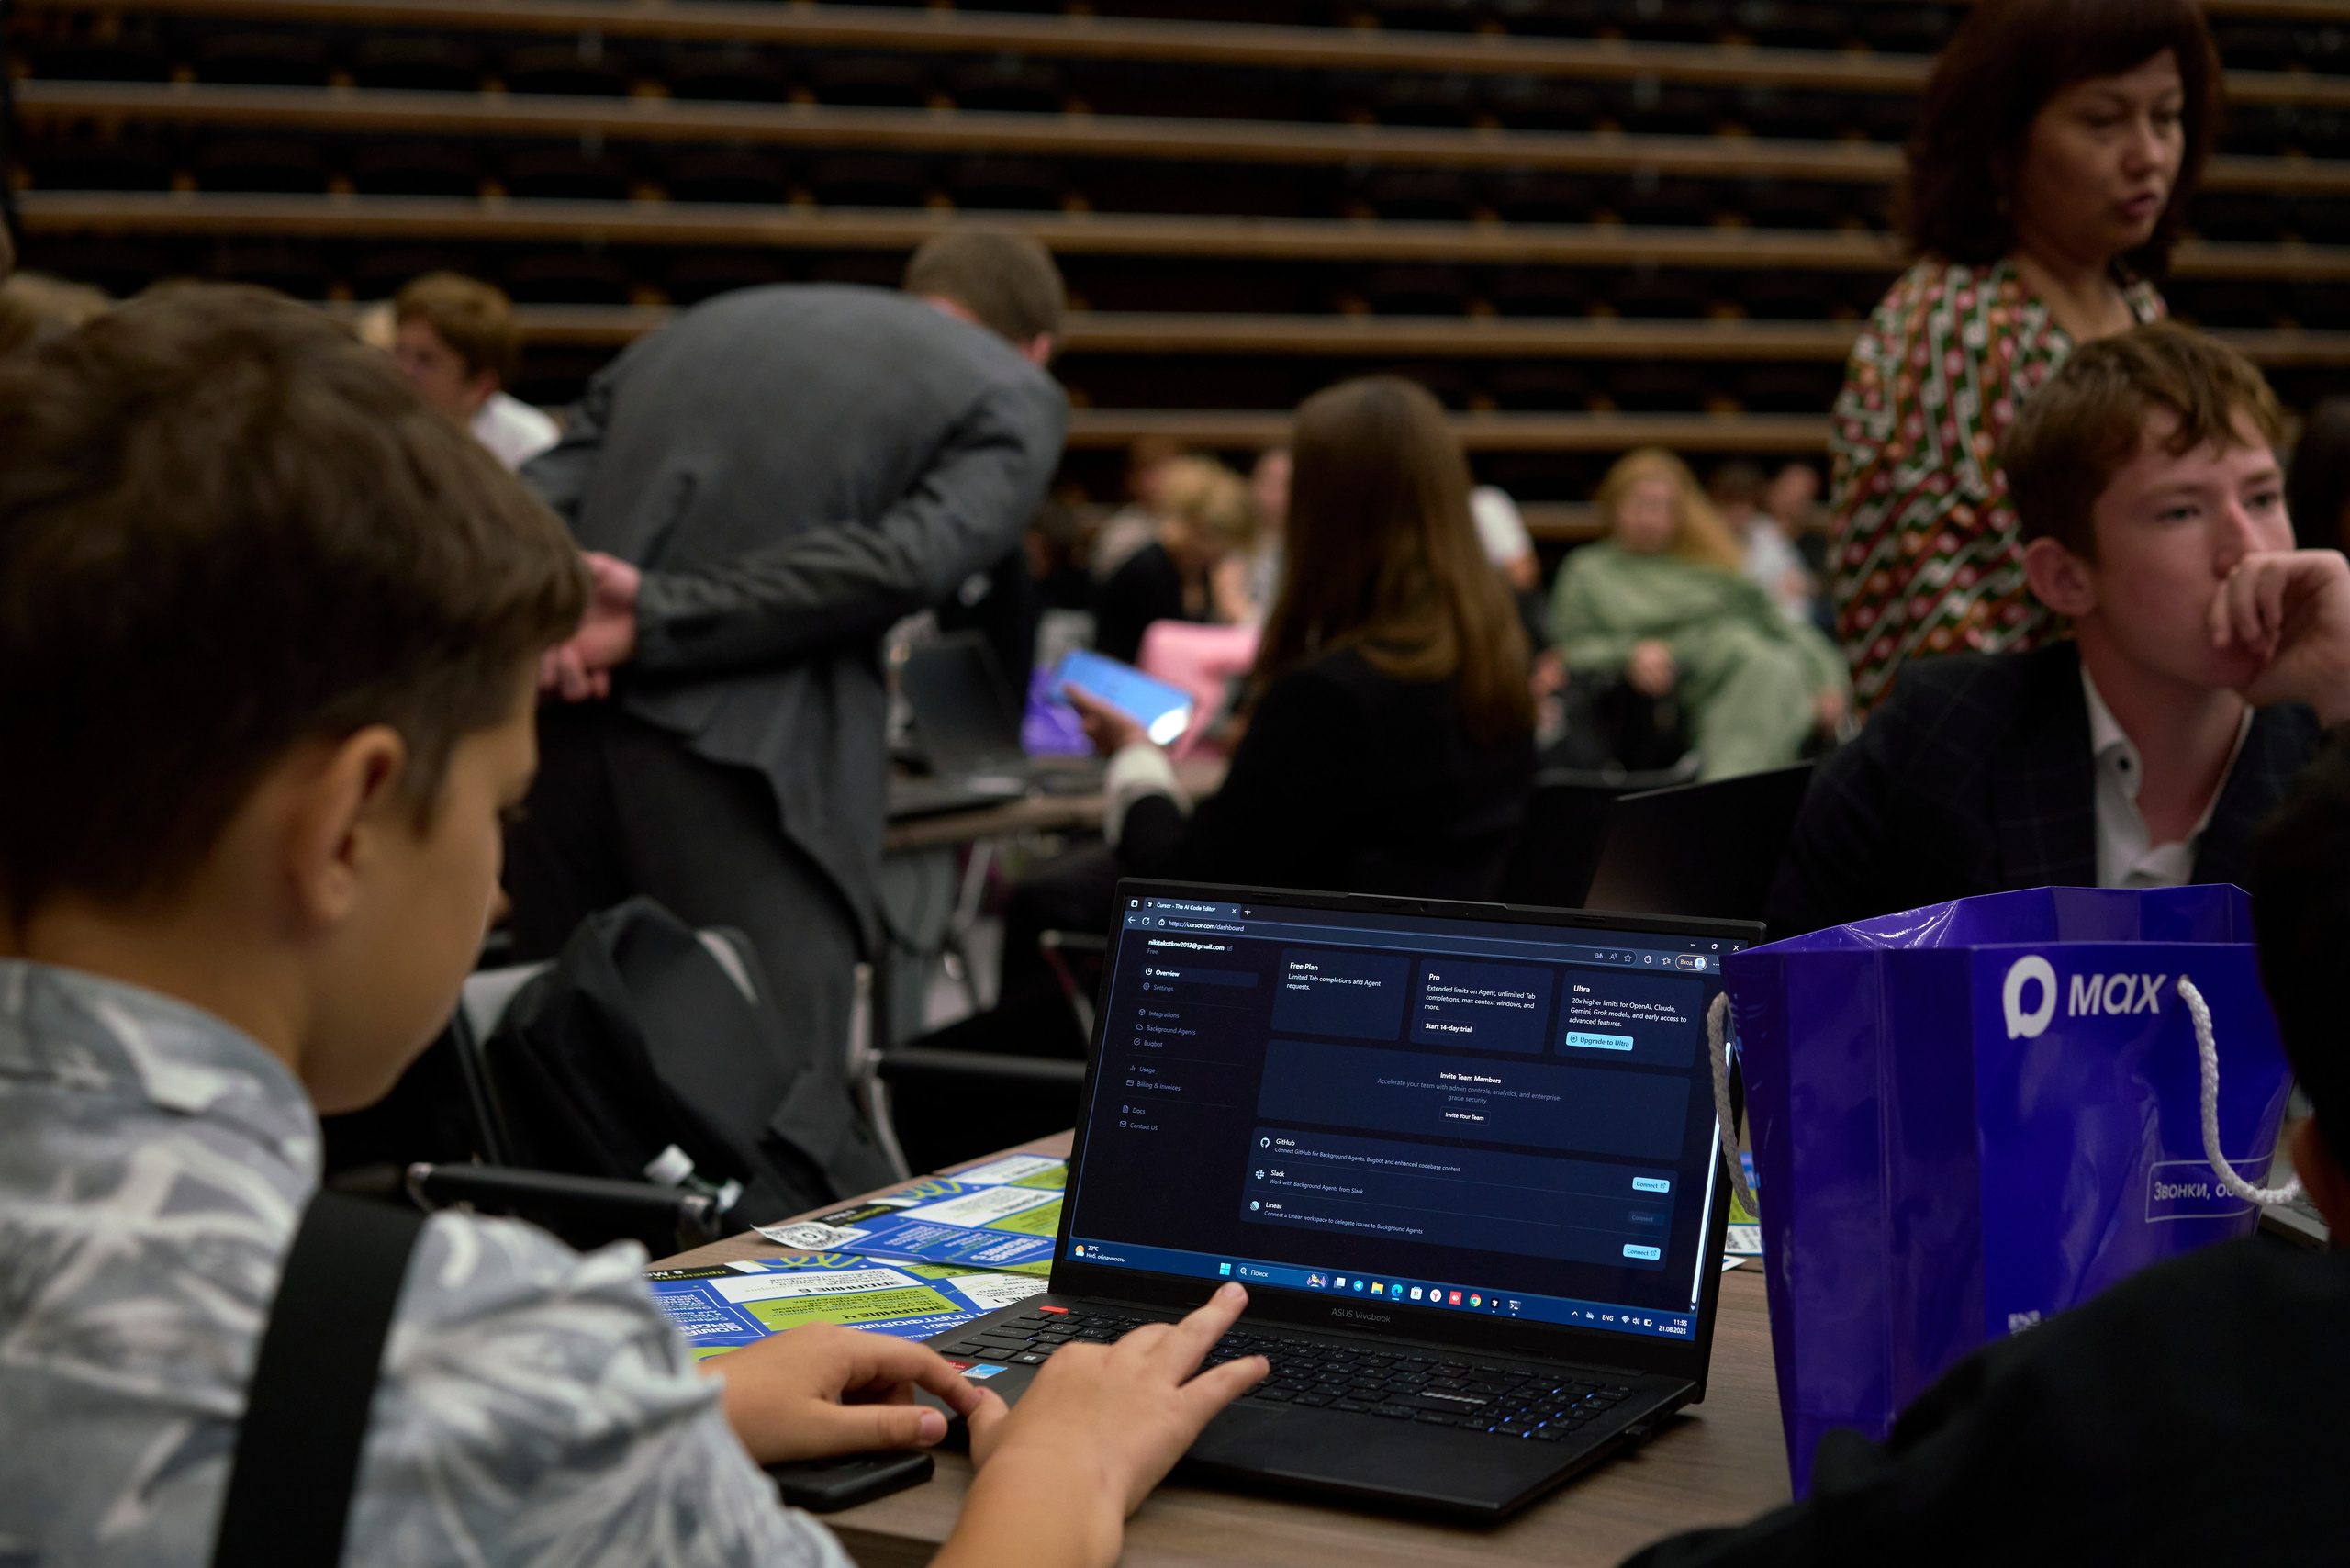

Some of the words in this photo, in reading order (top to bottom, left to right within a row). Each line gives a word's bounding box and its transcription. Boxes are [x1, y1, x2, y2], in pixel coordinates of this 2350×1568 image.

[1169, 920, 1245, 932] https://cursor.com/dashboard
[1304, 963, 1318, 971] Plan
[1364, 980, 1382, 988] Agent
[1153, 984, 1174, 993] Settings
[1573, 985, 1590, 993] Ultra
[1654, 1004, 1676, 1013] Claude,
[1149, 1011, 1180, 1019] Integrations
[1571, 1007, 1592, 1015] Gemini,
[1645, 1014, 1660, 1022] early
[1597, 1019, 1622, 1027] features.
[1147, 1025, 1177, 1034] Background
[1440, 1025, 1460, 1033] 14-day
[1144, 1040, 1163, 1048] Bugbot
[1580, 1037, 1606, 1046] Upgrade
[1377, 1078, 1406, 1086] Accelerate
[1474, 1076, 1501, 1084] Members
[1136, 1081, 1153, 1090] Billing
[1466, 1097, 1487, 1105] security
[1276, 1138, 1295, 1147] GitHub
[1320, 1152, 1348, 1160] Background
[1293, 1182, 1322, 1190] Background
[2154, 1181, 2210, 1201] Звонки,
[1631, 1215, 1653, 1223] Connect
[1377, 1224, 1405, 1232] Background
[1251, 1270, 1269, 1278] Поиск
[1331, 1308, 1353, 1318] ASUS
[1356, 1311, 1391, 1323] Vivobook
